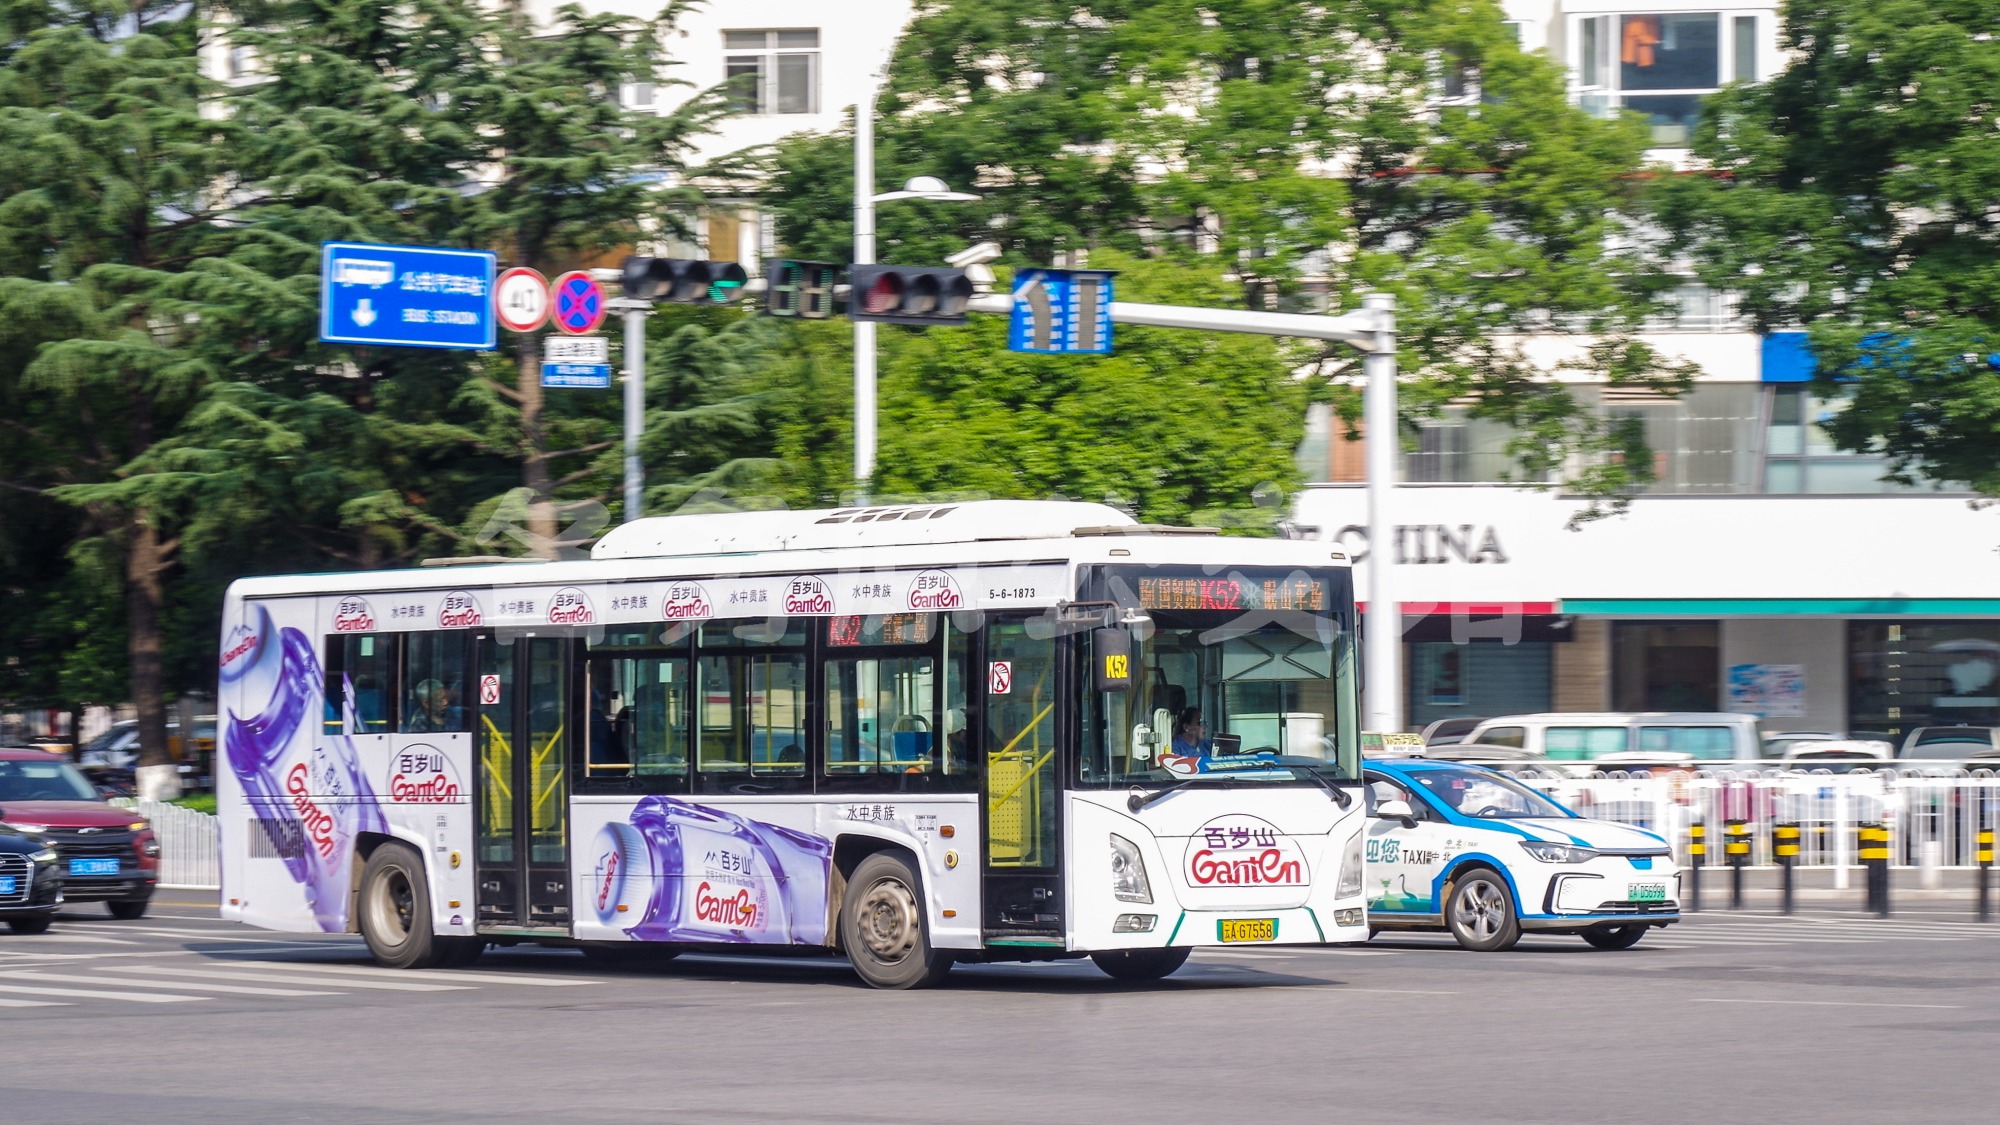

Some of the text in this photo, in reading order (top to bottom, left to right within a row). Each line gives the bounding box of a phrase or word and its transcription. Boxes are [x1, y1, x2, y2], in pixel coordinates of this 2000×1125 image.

[792, 580, 822, 595] 百岁山
[917, 575, 949, 590] 百岁山
[671, 586, 701, 600] 百岁山
[730, 588, 768, 604] 水中贵族
[852, 583, 892, 599] 水中贵族
[989, 587, 1036, 600] 5-6-1873
[1201, 580, 1240, 610] K52
[446, 597, 473, 610] 百岁山
[499, 601, 534, 615] 水中贵族
[556, 593, 584, 607] 百岁山
[611, 595, 648, 611] 水中贵族
[340, 601, 366, 616] 百岁山
[391, 605, 426, 619] 水中贵族
[1105, 654, 1128, 679] K52
[400, 754, 443, 775] 百岁山
[391, 774, 458, 803] Ganten
[847, 805, 895, 822] 水中贵族
[1204, 826, 1277, 850] 百岁山
[721, 850, 751, 876] 百岁山
[1403, 849, 1426, 865] TAXI
[1191, 848, 1300, 884] Ganten
[696, 881, 757, 928] Ganten
